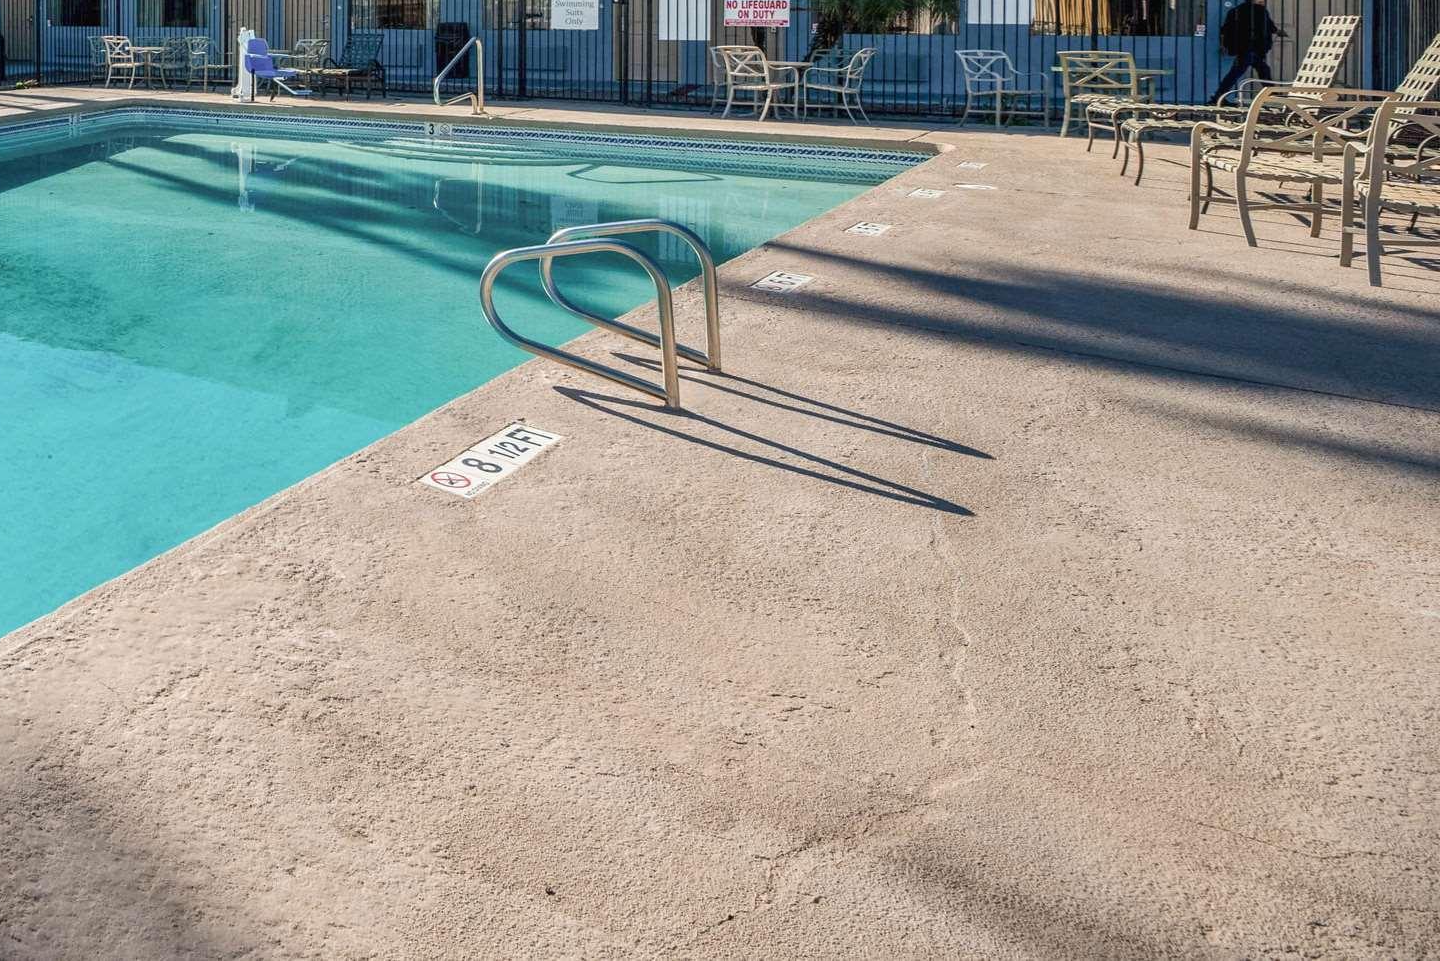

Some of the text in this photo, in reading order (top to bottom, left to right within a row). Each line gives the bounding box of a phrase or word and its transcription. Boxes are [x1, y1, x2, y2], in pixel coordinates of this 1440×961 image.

[554, 0, 595, 8] Swimming
[726, 1, 787, 9] NO LIFEGUARD
[737, 10, 775, 18] ON DUTY
[429, 123, 434, 134] 3
[461, 457, 503, 474] 8
